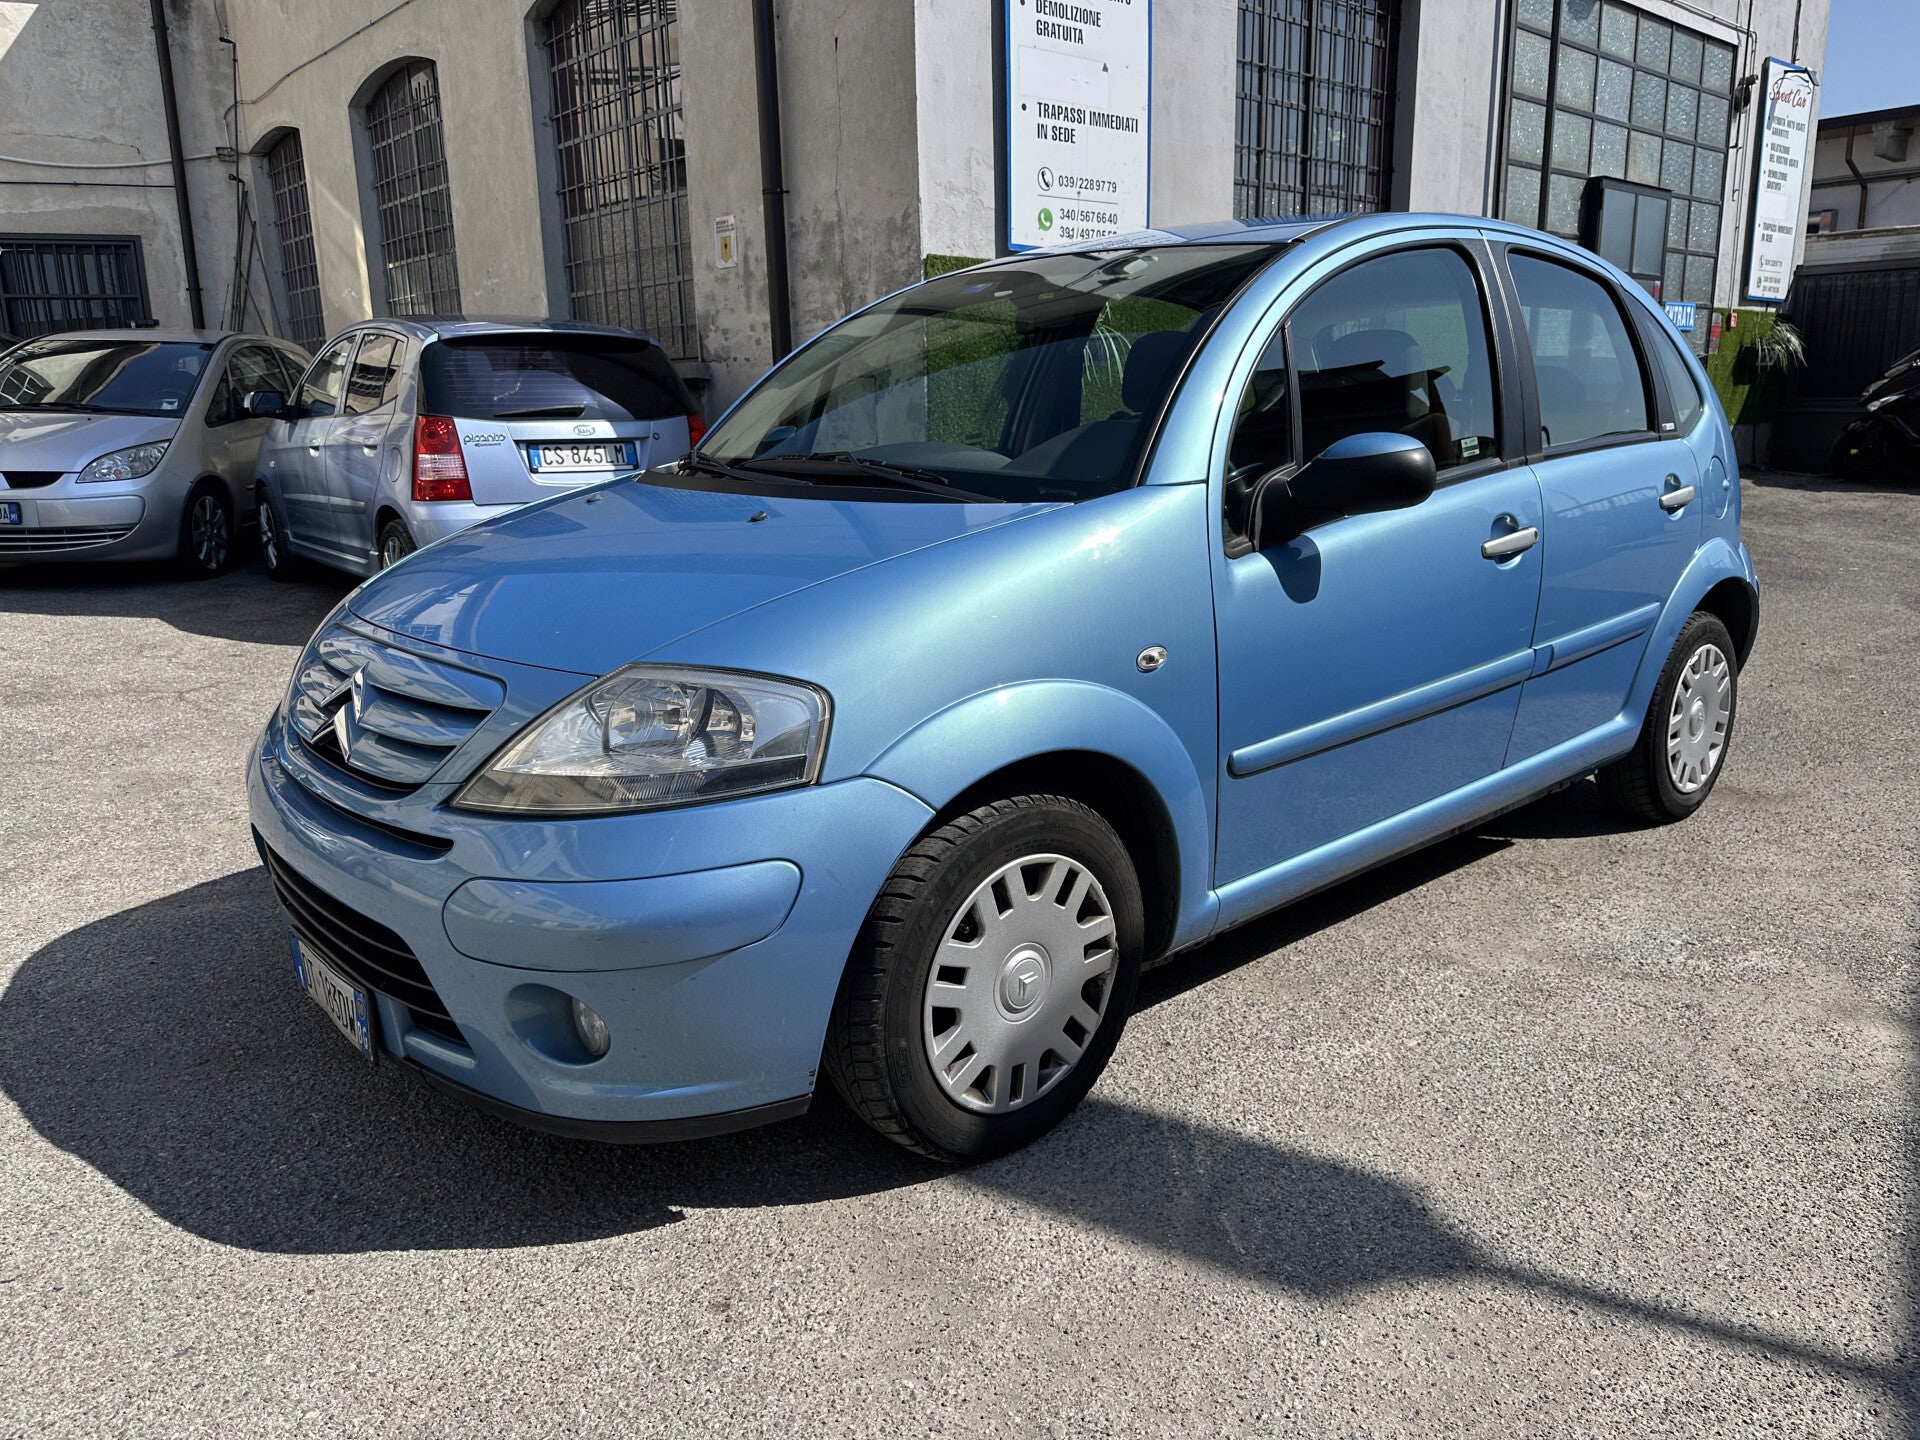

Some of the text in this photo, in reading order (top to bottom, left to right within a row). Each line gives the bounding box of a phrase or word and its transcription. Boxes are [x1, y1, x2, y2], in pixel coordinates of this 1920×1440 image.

[1036, 0, 1101, 27] DEMOLIZIONE
[1036, 20, 1084, 45] GRATUITA
[1037, 102, 1138, 133] TRAPASSI IMMEDIATI
[1037, 123, 1076, 144] IN SEDE
[1058, 175, 1117, 193] 039/2289779
[1060, 208, 1118, 225] 340/5676640
[543, 446, 565, 465] CS
[571, 445, 626, 464] 845LM
